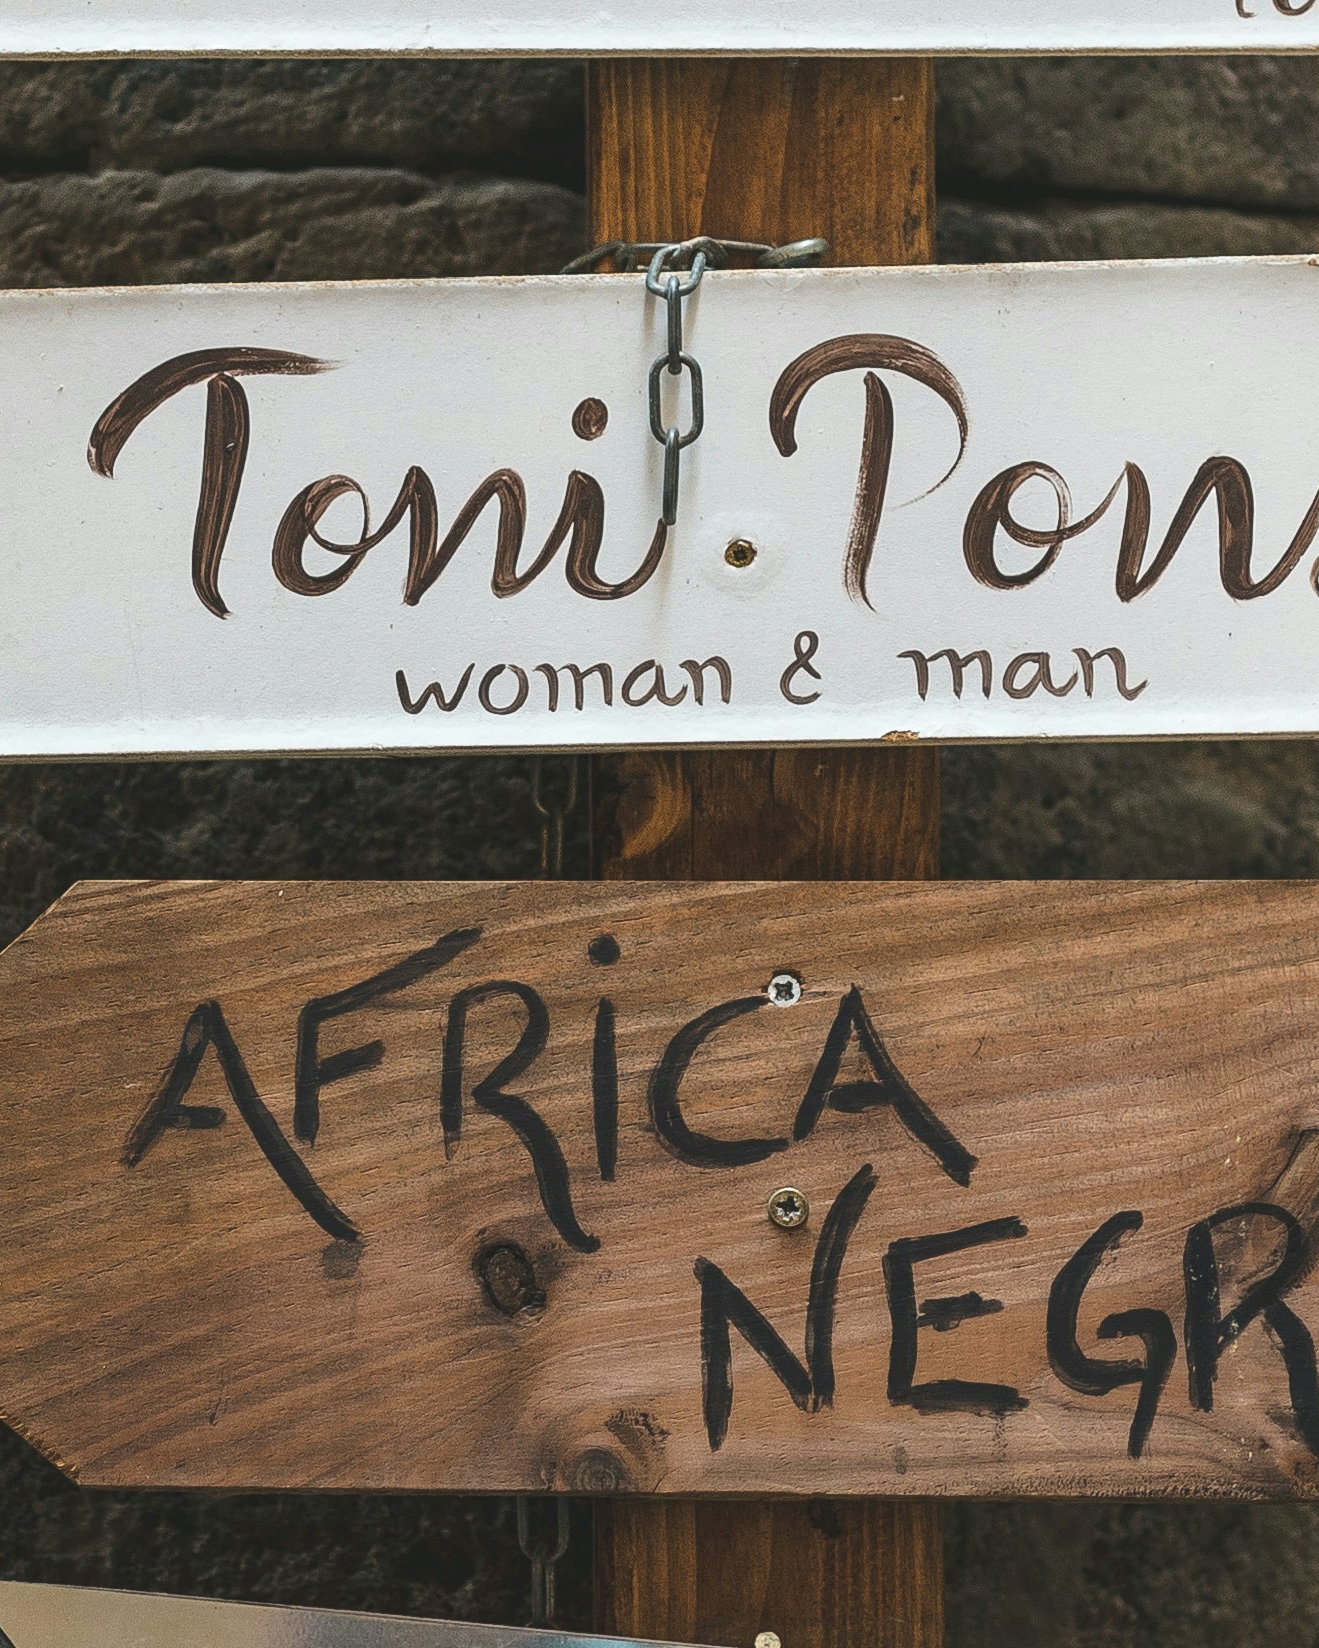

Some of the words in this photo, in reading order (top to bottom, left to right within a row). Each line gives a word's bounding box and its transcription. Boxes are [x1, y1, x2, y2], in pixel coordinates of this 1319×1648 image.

[88, 345, 666, 620] Toni
[395, 654, 733, 716] woman
[779, 630, 822, 705] &
[896, 647, 1149, 702] man
